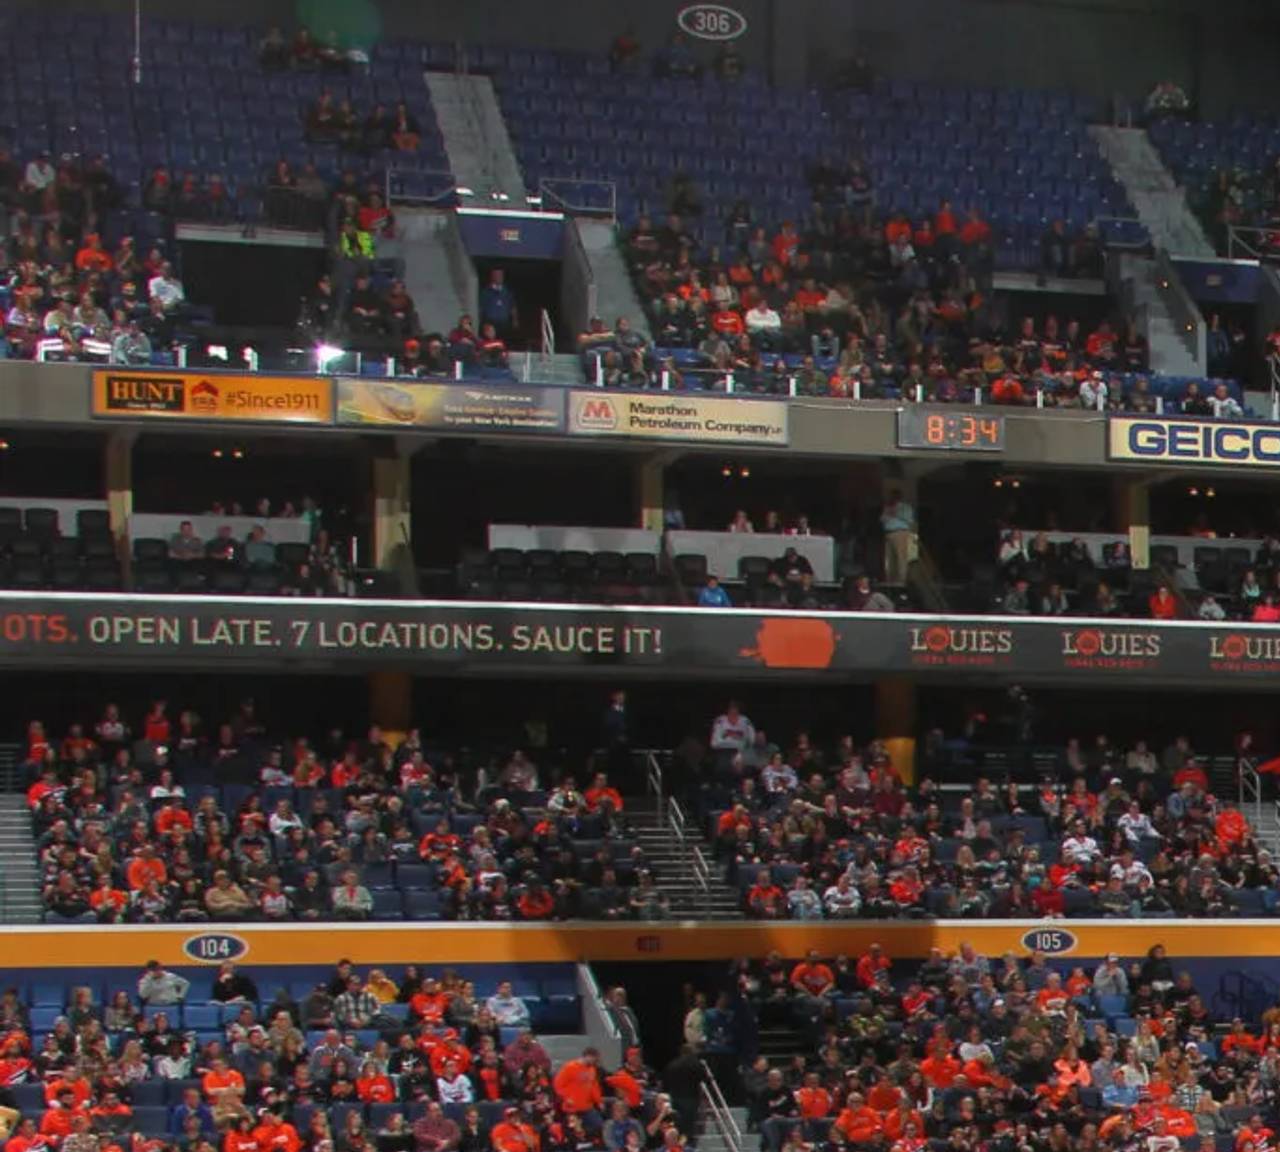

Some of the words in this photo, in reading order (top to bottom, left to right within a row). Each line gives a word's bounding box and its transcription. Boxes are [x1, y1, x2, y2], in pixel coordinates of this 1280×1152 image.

[695, 12, 730, 32] 306
[112, 381, 176, 401] HUNT
[226, 391, 320, 409] #Since1911
[629, 402, 697, 417] Marathon
[629, 415, 700, 431] Petroleum
[705, 419, 770, 434] Company
[927, 415, 998, 445] 8:34
[89, 617, 180, 644] OPEN
[191, 619, 282, 646] LATE.
[291, 622, 310, 647] 7
[319, 622, 504, 650] LOCATIONS.
[512, 626, 615, 653] SAUCE
[624, 628, 661, 654] IT!
[201, 938, 230, 956] 104
[1036, 932, 1061, 950] 105
